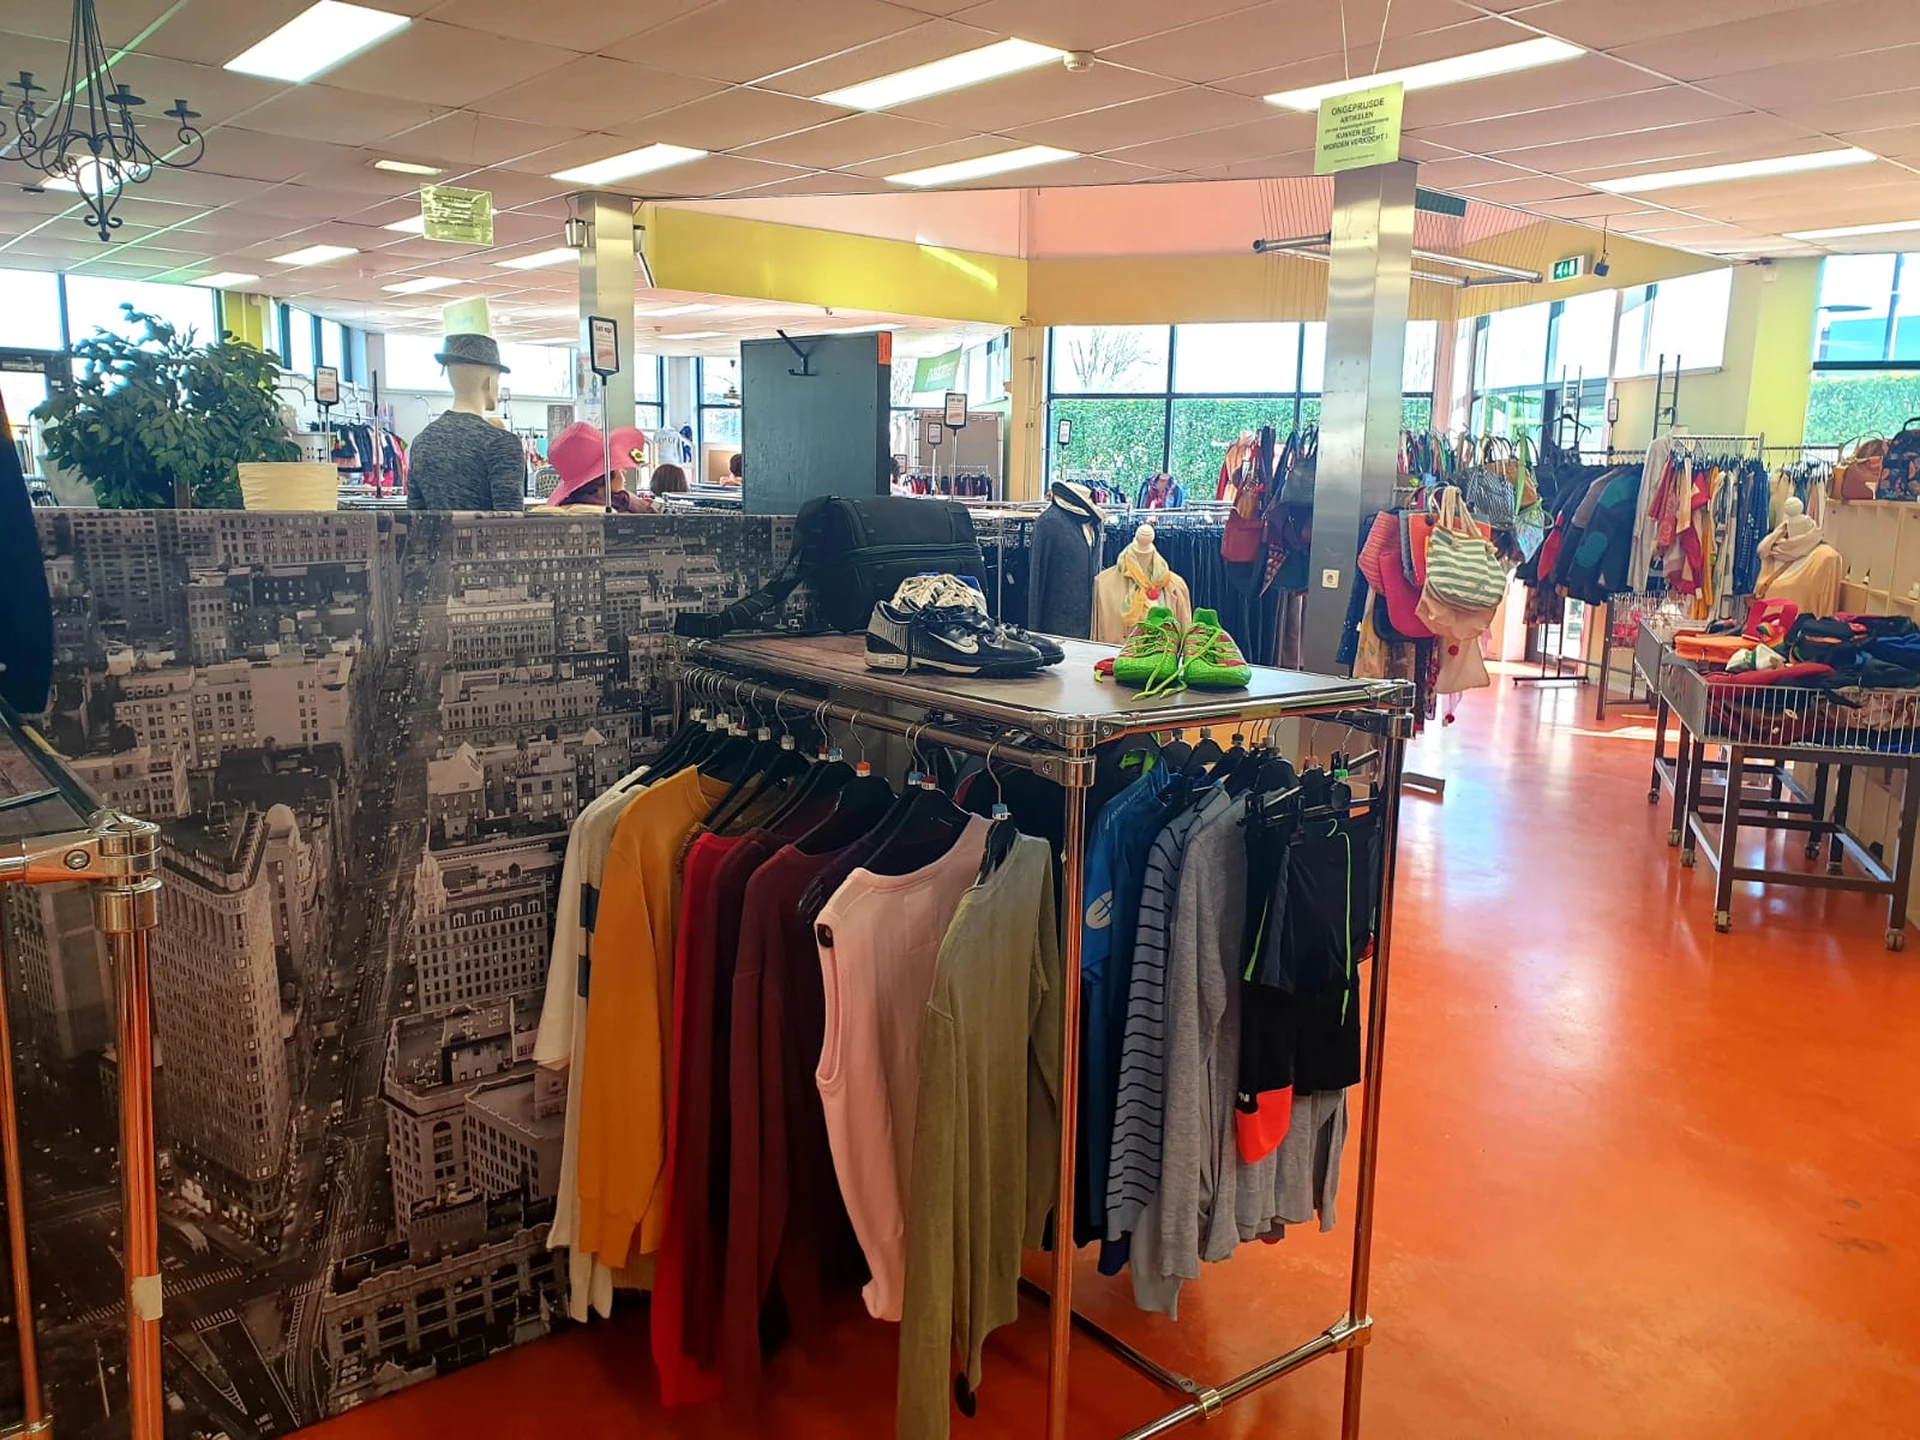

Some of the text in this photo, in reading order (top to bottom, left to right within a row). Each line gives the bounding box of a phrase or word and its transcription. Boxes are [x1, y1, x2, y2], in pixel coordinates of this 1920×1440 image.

[1339, 111, 1375, 124] ARTIKELEN
[1335, 129, 1361, 140] KUNNEN
[1323, 140, 1350, 151] WORDEN
[1350, 135, 1385, 147] VERKOCHT
